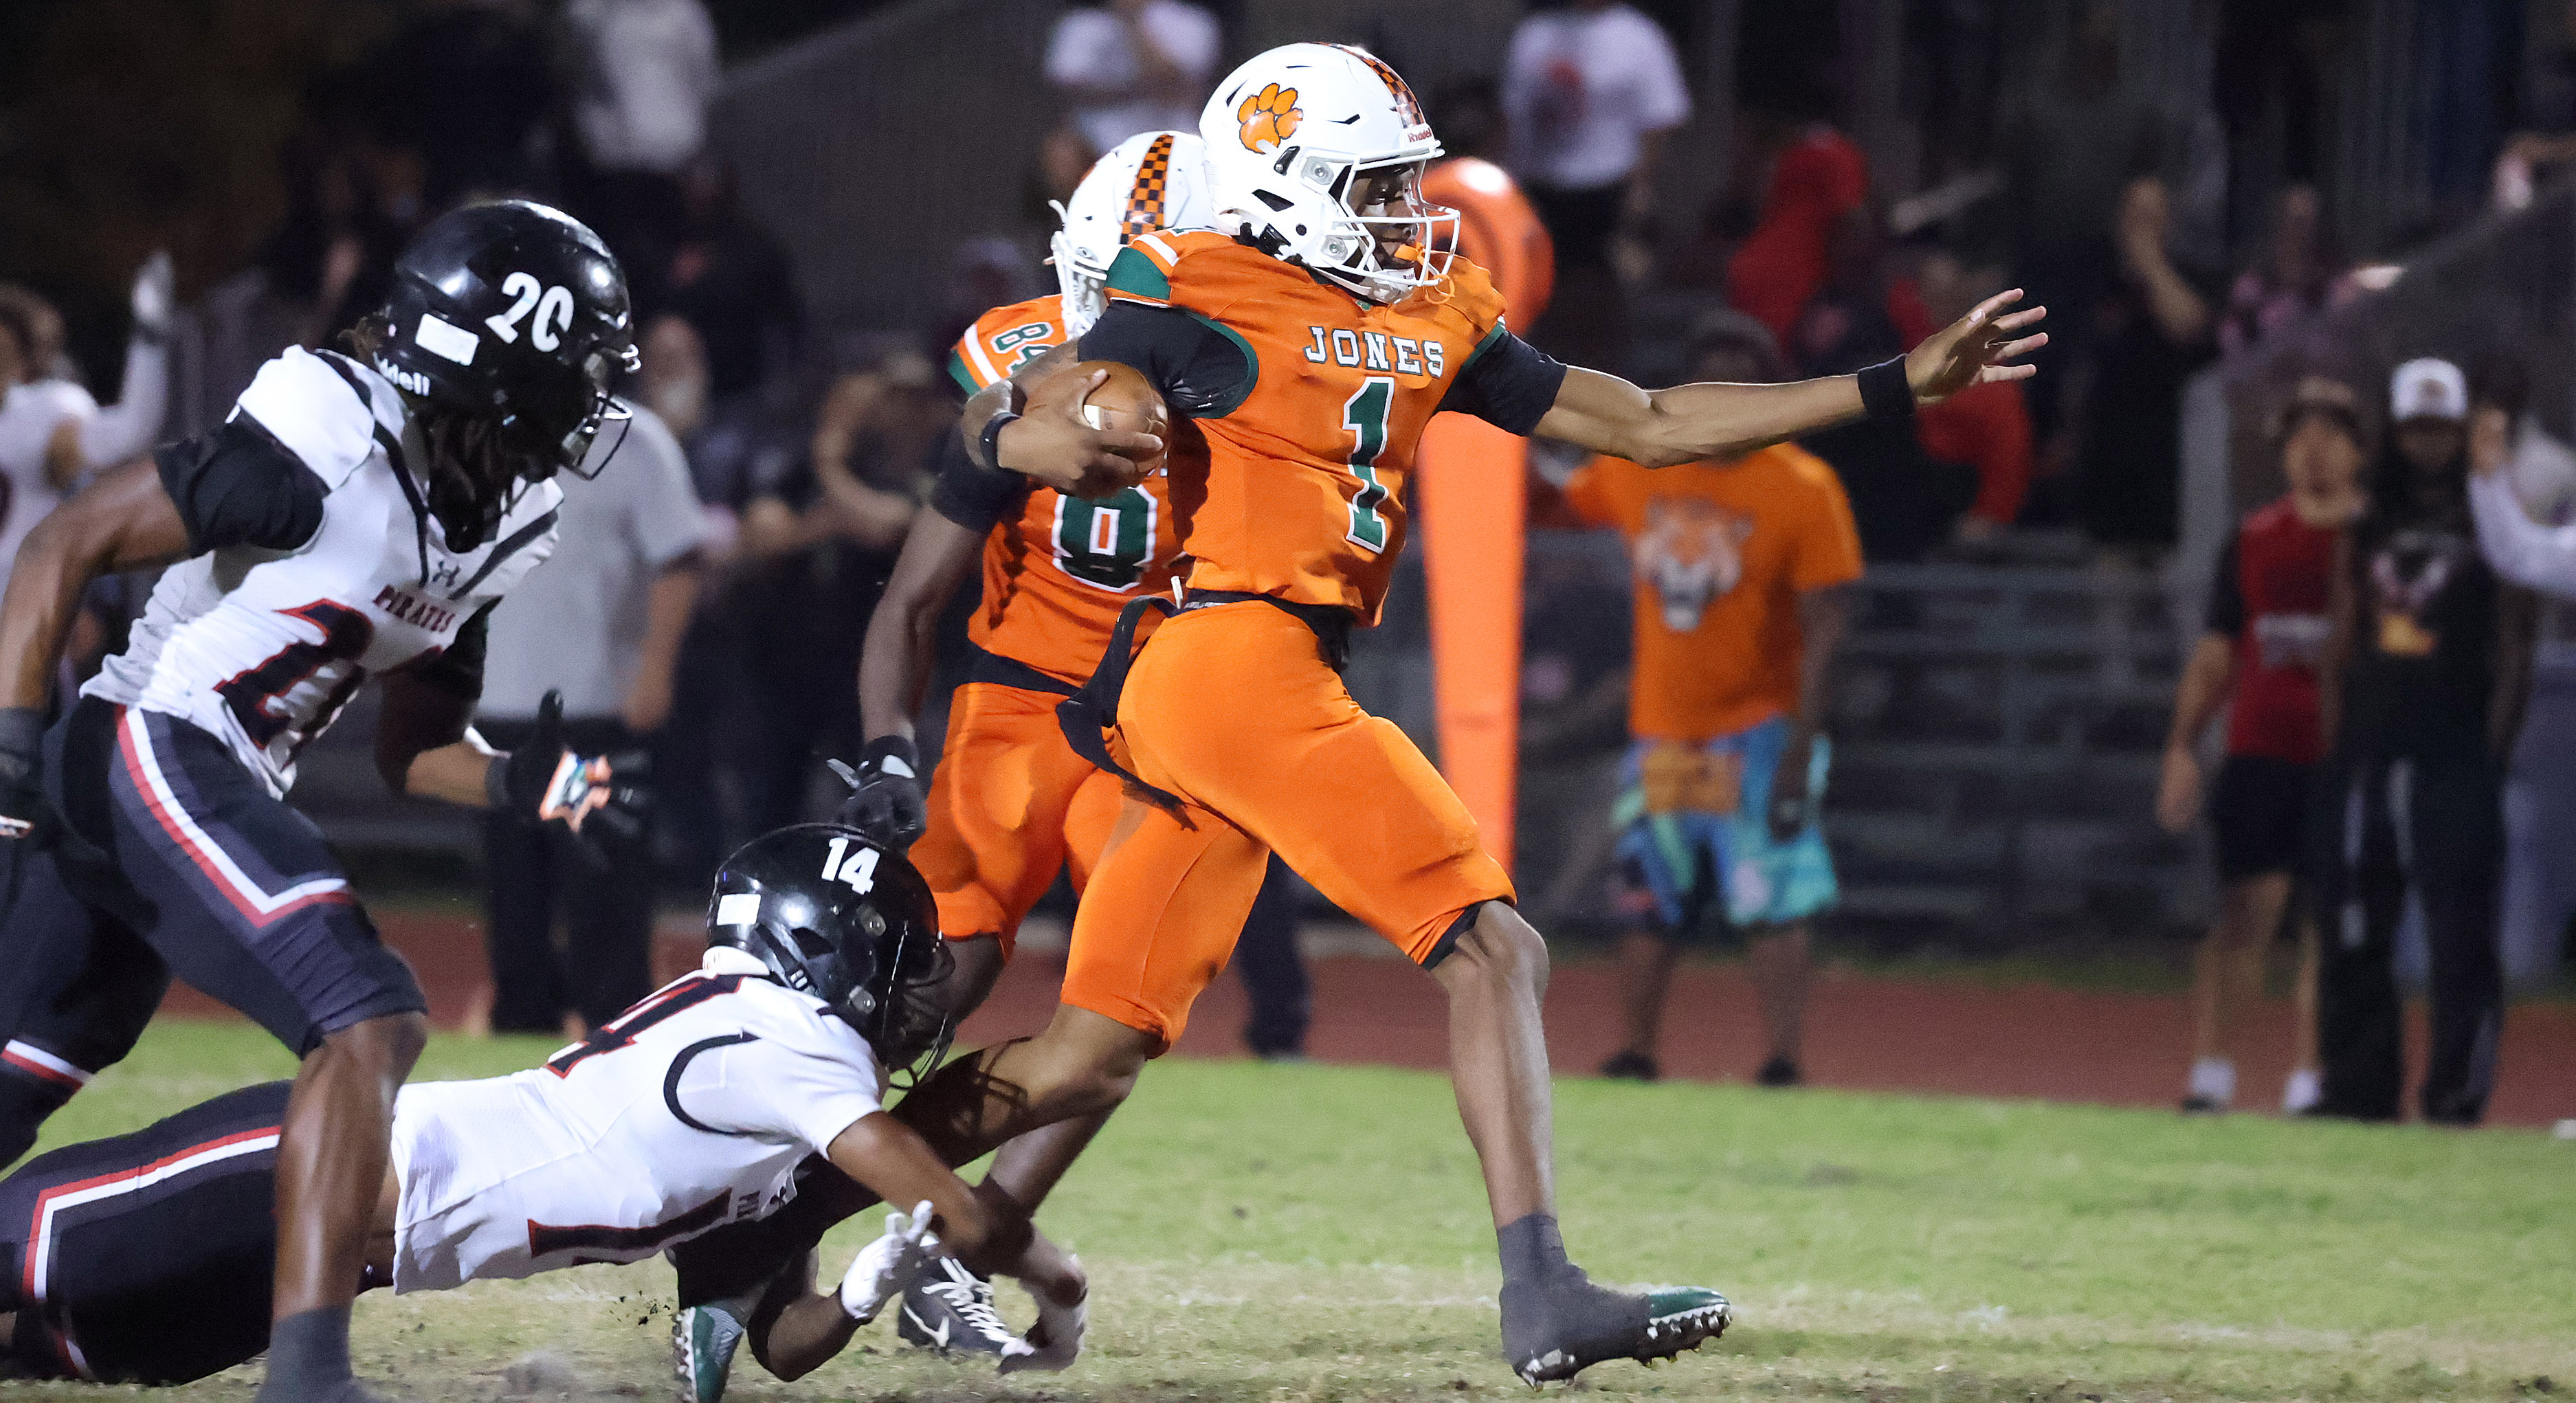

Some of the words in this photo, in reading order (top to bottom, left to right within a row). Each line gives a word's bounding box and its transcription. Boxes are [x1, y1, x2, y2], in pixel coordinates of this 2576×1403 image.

[485, 271, 574, 352] 20
[1304, 326, 1444, 378] JONES
[1342, 377, 1395, 554] 1
[373, 584, 456, 633] PIRATES
[821, 837, 880, 895] 14
